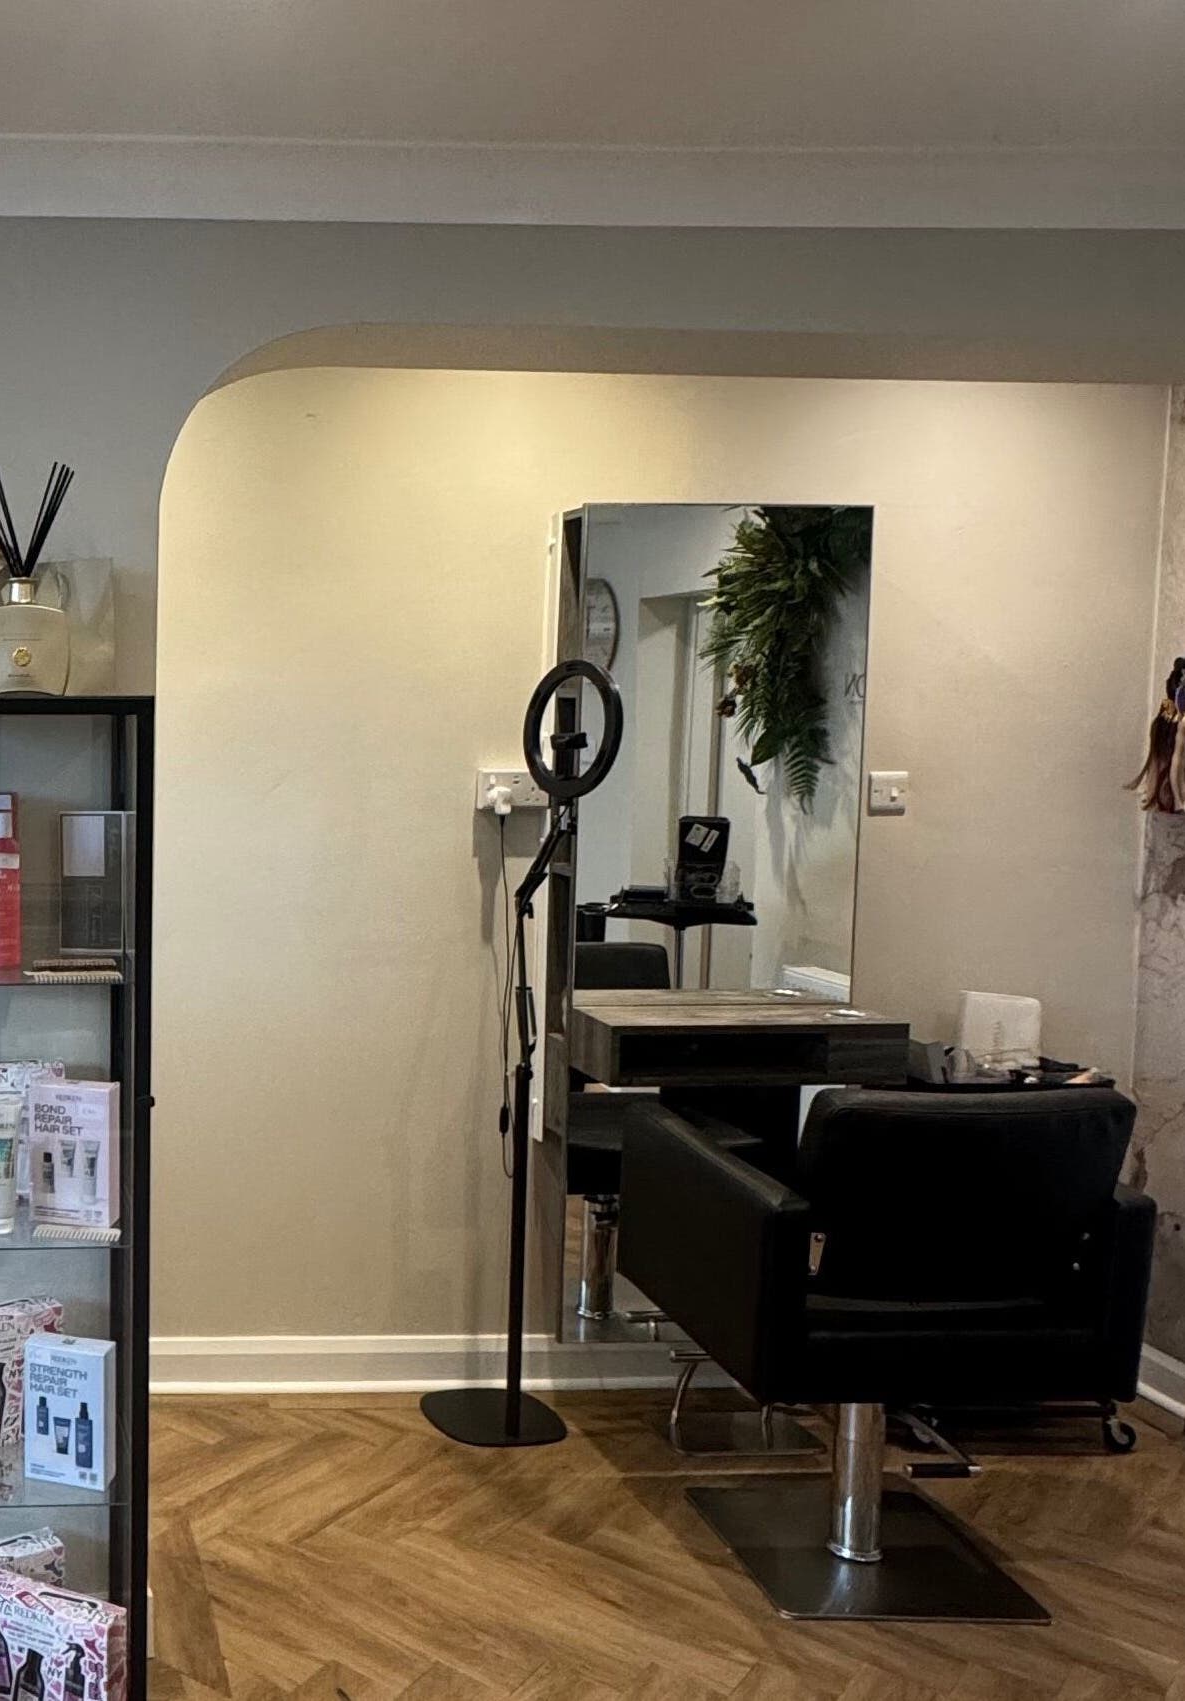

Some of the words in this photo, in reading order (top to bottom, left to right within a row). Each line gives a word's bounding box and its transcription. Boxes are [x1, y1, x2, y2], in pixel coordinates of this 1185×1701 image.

[34, 1103, 66, 1115] BOND
[34, 1113, 72, 1125] REPAIR
[34, 1124, 60, 1134] HAIR
[62, 1126, 83, 1136] SET
[29, 1363, 88, 1381] STRENGTH
[29, 1372, 67, 1387] REPAIR
[30, 1383, 55, 1395] HAIR
[57, 1386, 78, 1399] SET
